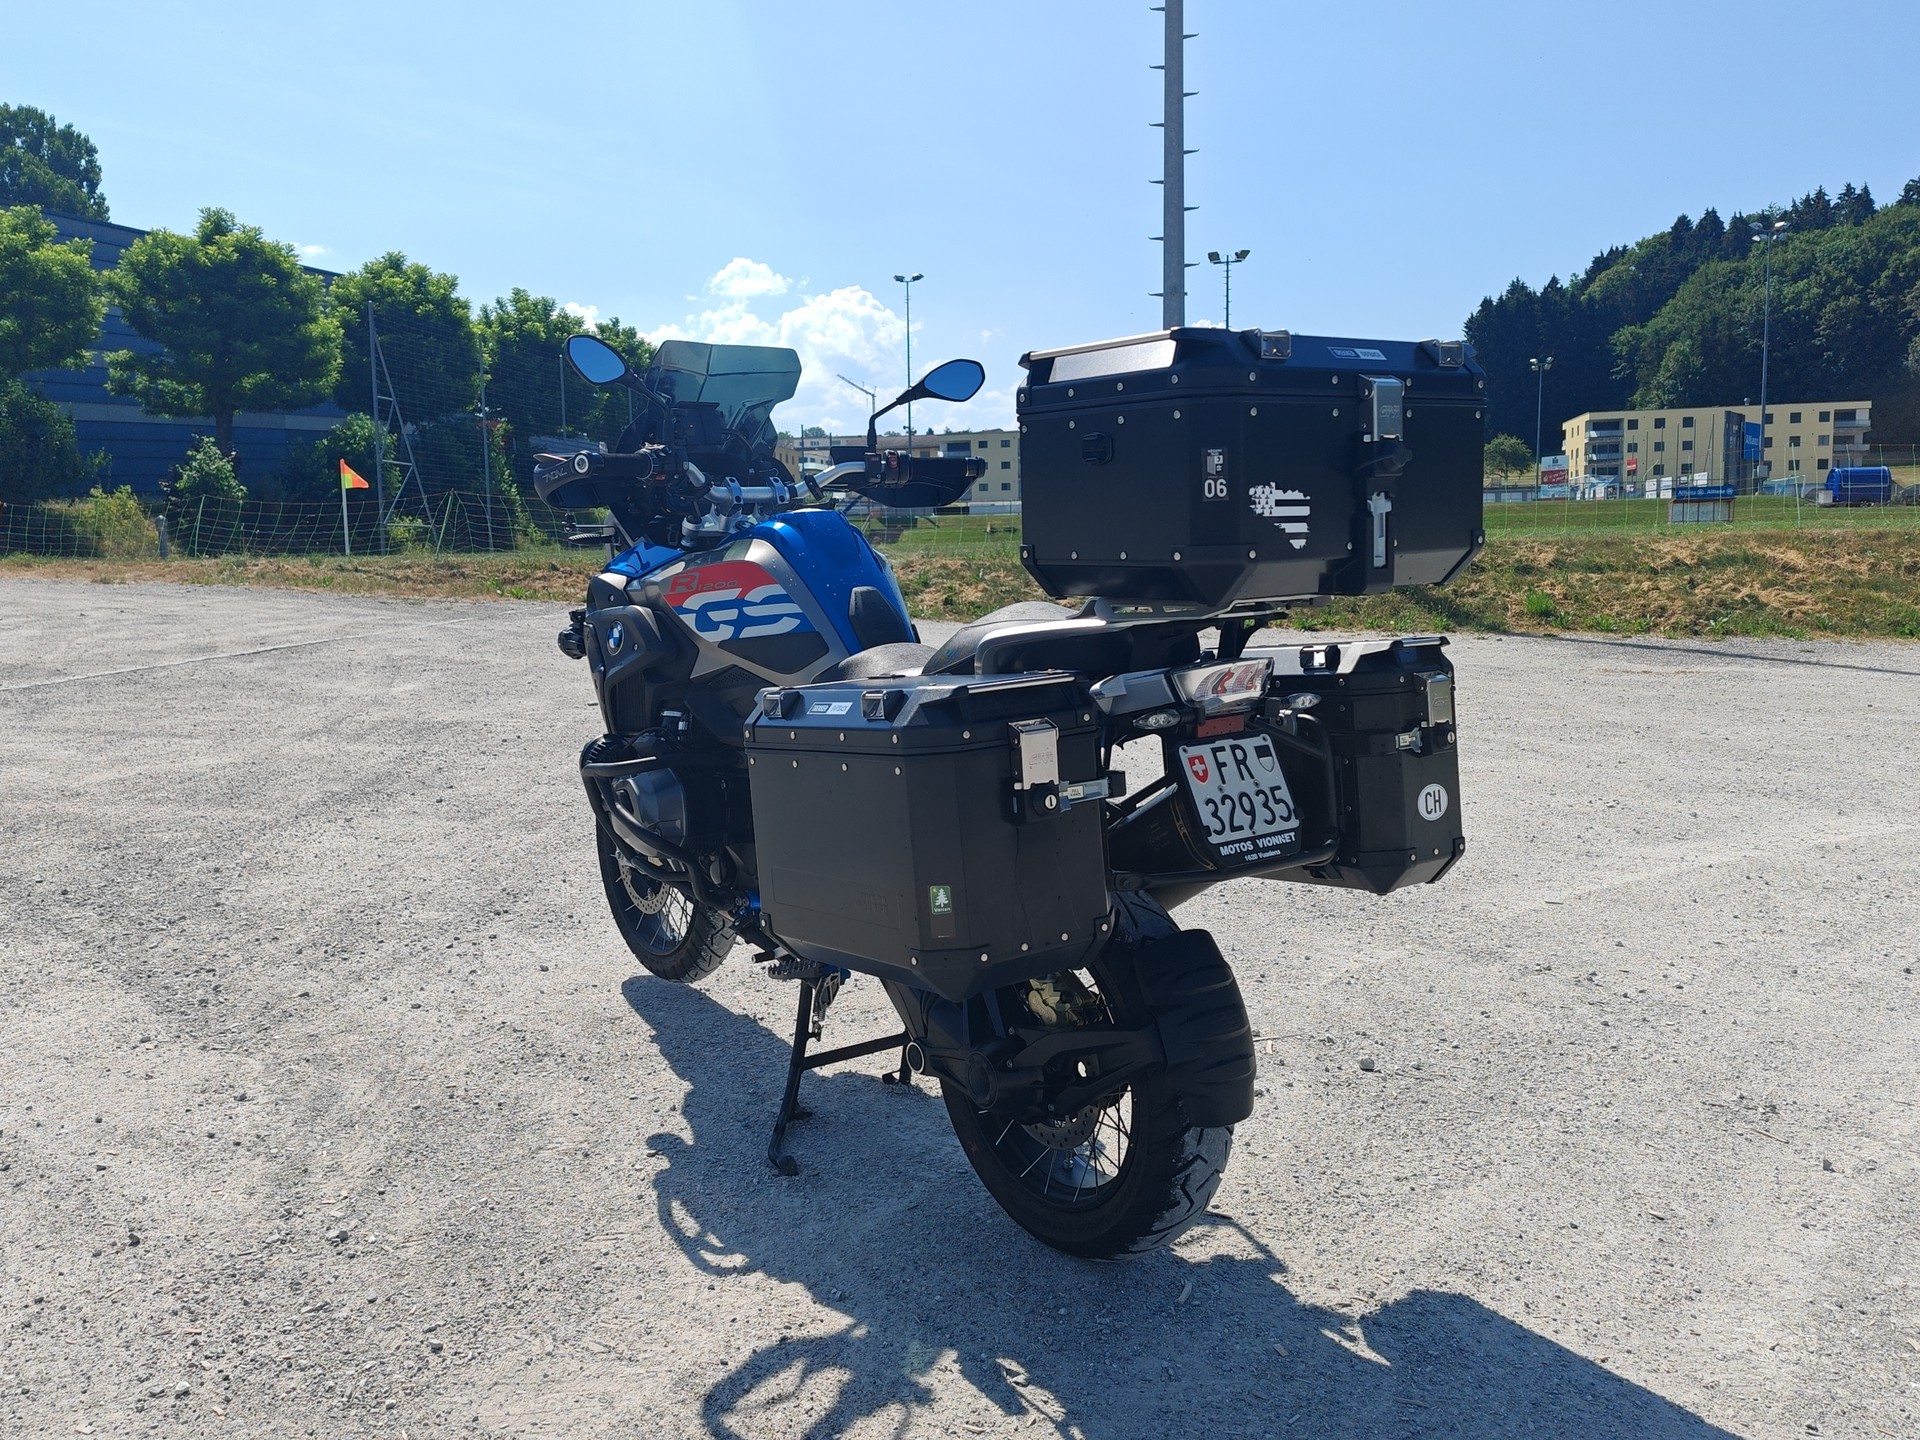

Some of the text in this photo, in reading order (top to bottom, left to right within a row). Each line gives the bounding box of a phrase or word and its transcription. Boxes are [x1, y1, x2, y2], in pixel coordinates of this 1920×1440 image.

[1204, 479, 1227, 498] 06
[678, 584, 803, 642] GS
[1210, 744, 1255, 785] FR
[1205, 785, 1292, 836] 32935
[1425, 789, 1442, 815] CH
[1219, 831, 1297, 857] MOTOS VIONNET
